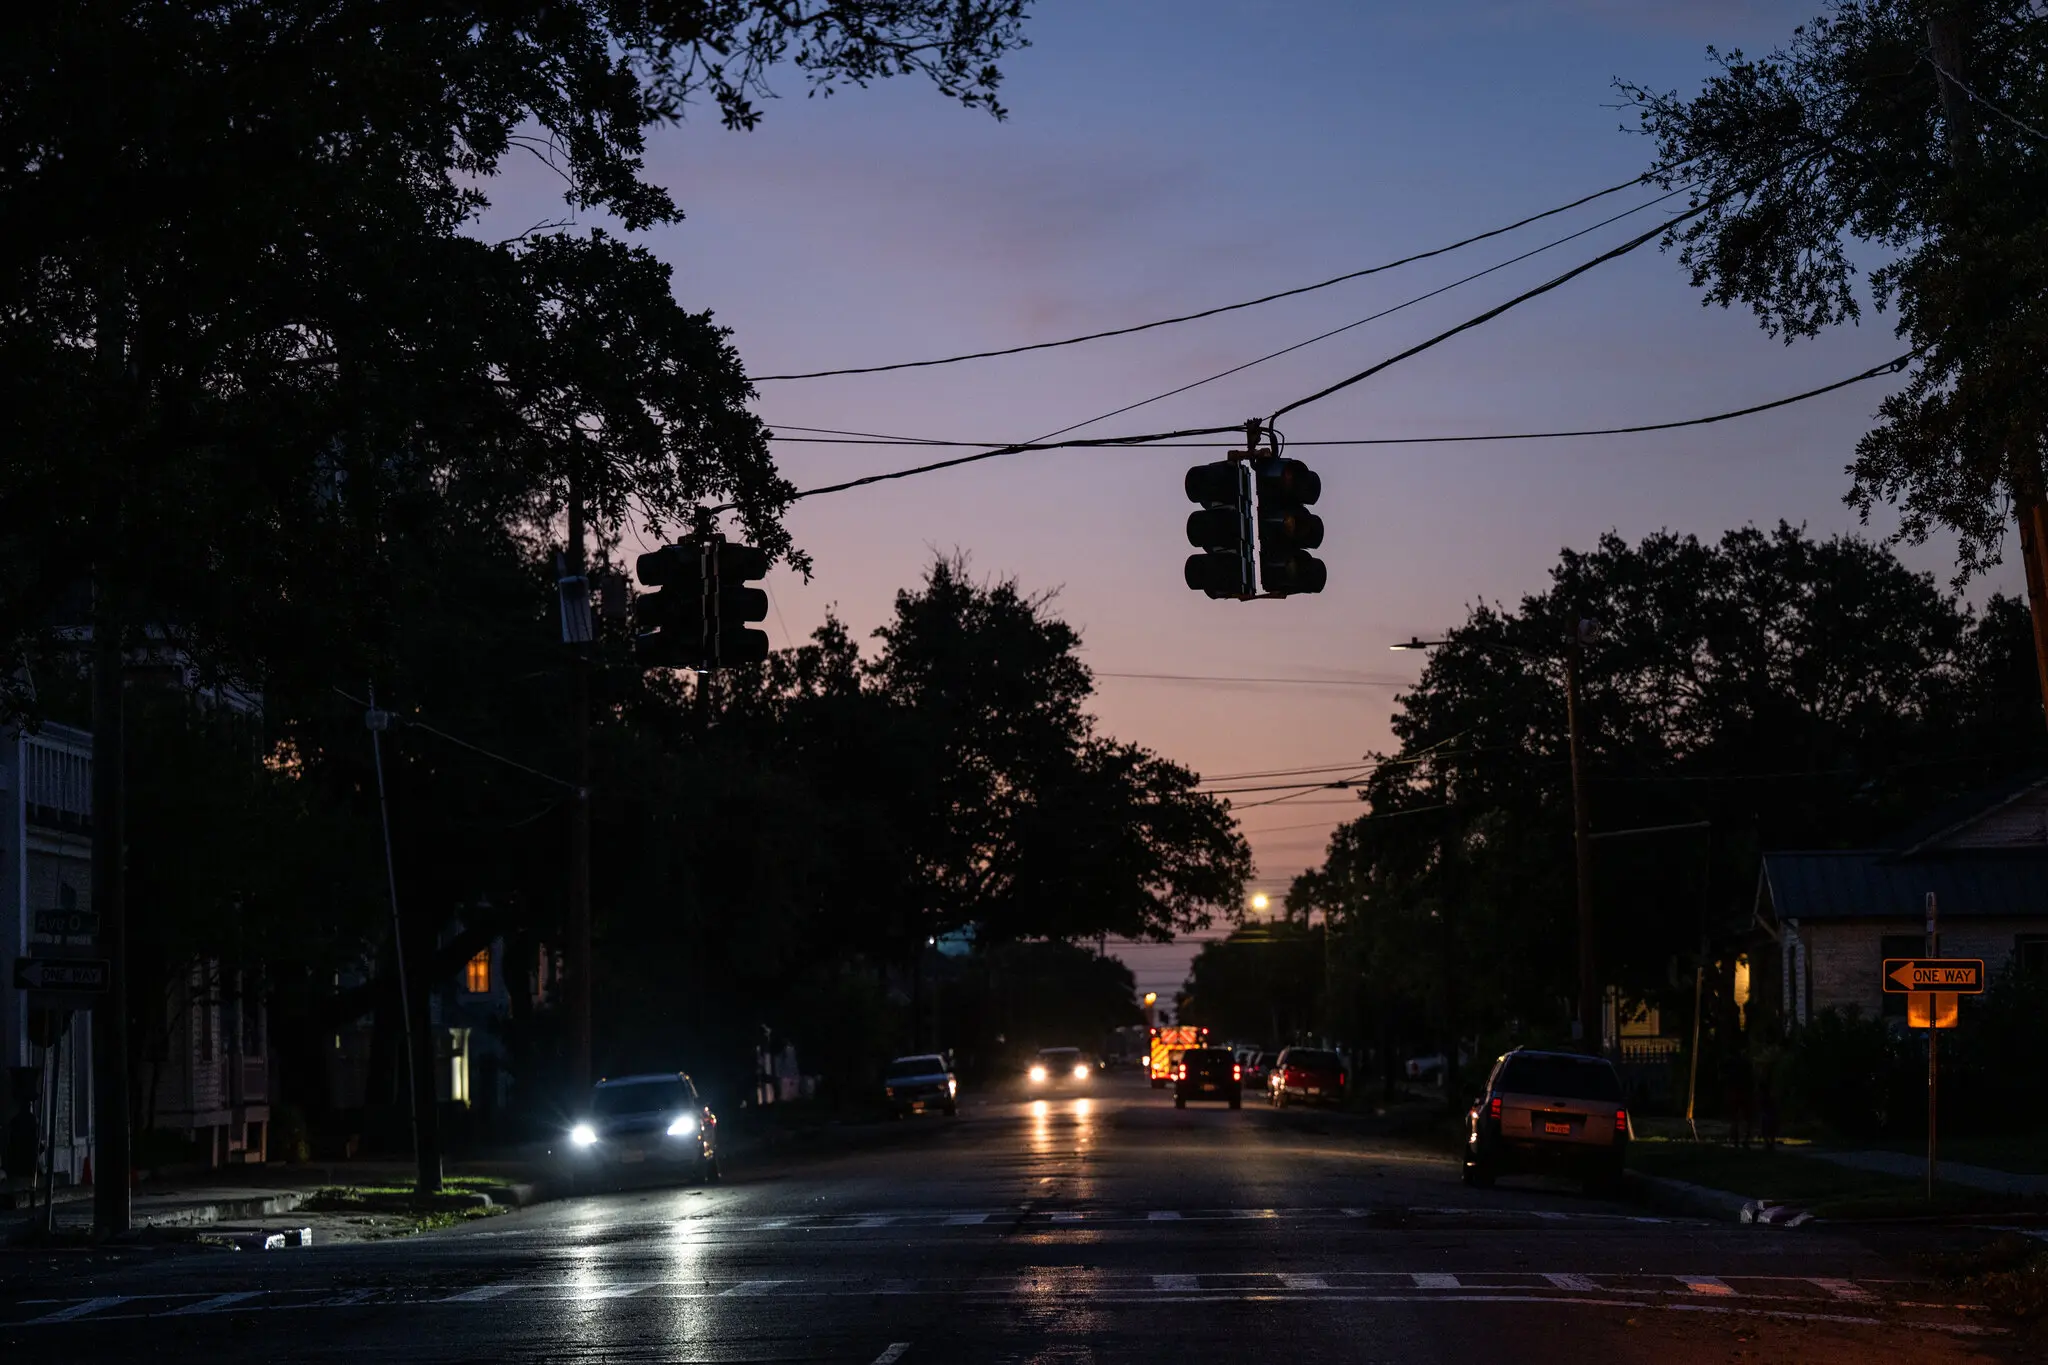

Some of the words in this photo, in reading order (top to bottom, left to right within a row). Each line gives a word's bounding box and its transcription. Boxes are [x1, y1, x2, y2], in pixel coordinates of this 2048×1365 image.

[42, 967, 66, 981] ONE
[72, 967, 98, 981] WAY
[1913, 969, 1940, 982] ONE
[1944, 969, 1972, 982] WAY
